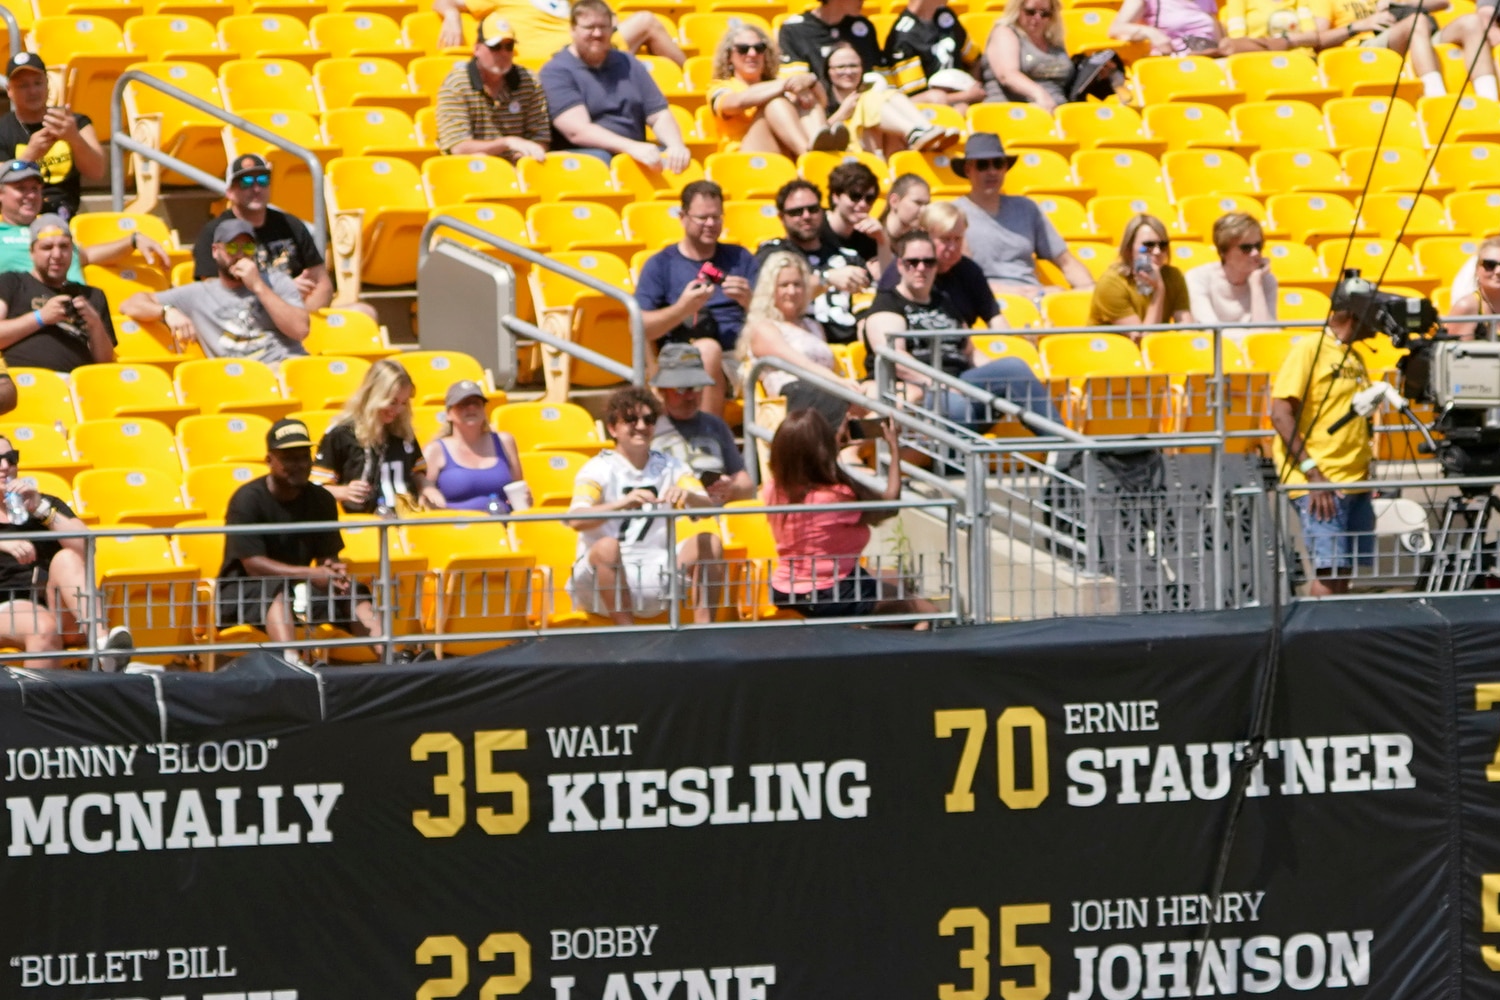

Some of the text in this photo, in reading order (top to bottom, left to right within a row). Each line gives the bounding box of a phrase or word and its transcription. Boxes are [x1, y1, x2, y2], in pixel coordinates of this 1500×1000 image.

[1064, 700, 1160, 735] ERNIE
[546, 724, 639, 759] WALT
[934, 706, 1050, 813] 70
[5, 745, 138, 782] JOHNNY
[410, 729, 531, 839] 35
[1066, 732, 1417, 808] STAUTNER
[547, 759, 872, 833] KIESLING
[6, 783, 344, 857] MCNALLY
[1068, 891, 1266, 932] JOHN HENRY
[167, 946, 237, 980] BILL
[550, 925, 659, 961] BOBBY
